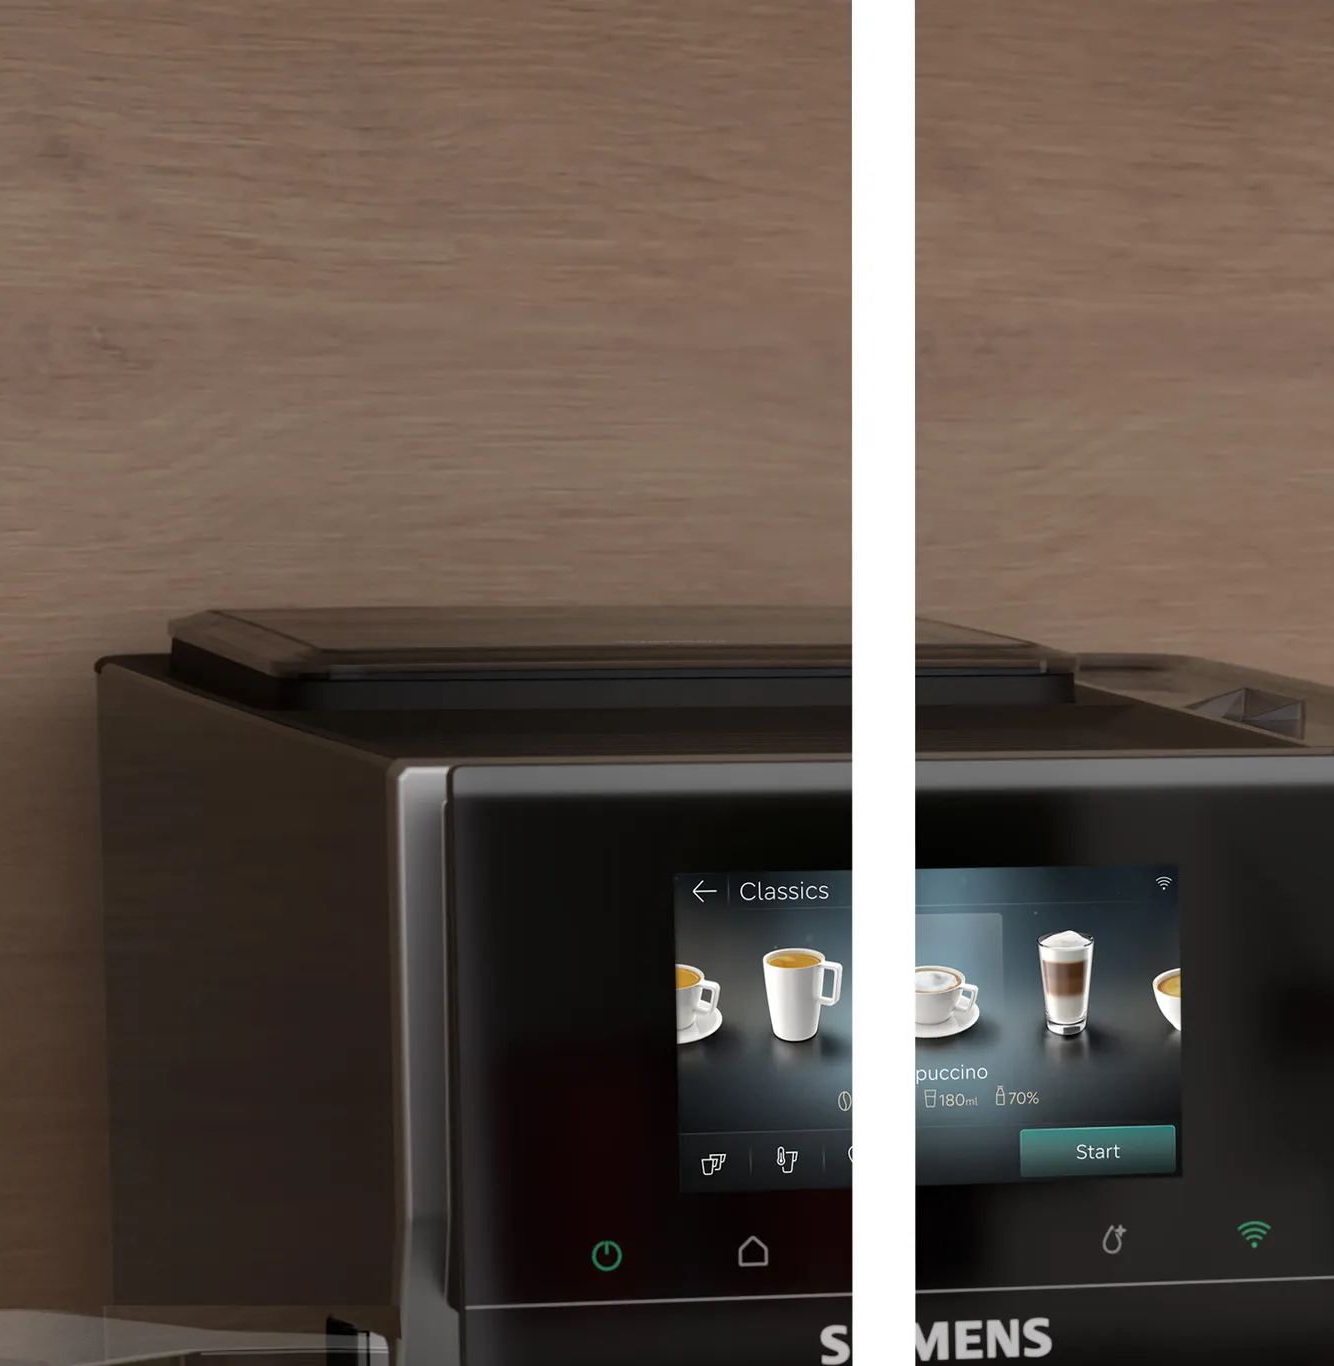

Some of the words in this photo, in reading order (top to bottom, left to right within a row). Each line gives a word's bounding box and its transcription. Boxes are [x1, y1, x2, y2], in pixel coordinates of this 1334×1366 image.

[739, 881, 829, 901] Classics
[915, 1064, 988, 1084] puccino
[1008, 1091, 1040, 1105] 70%
[1076, 1144, 1121, 1160] Start
[820, 1317, 1053, 1366] SMENS
